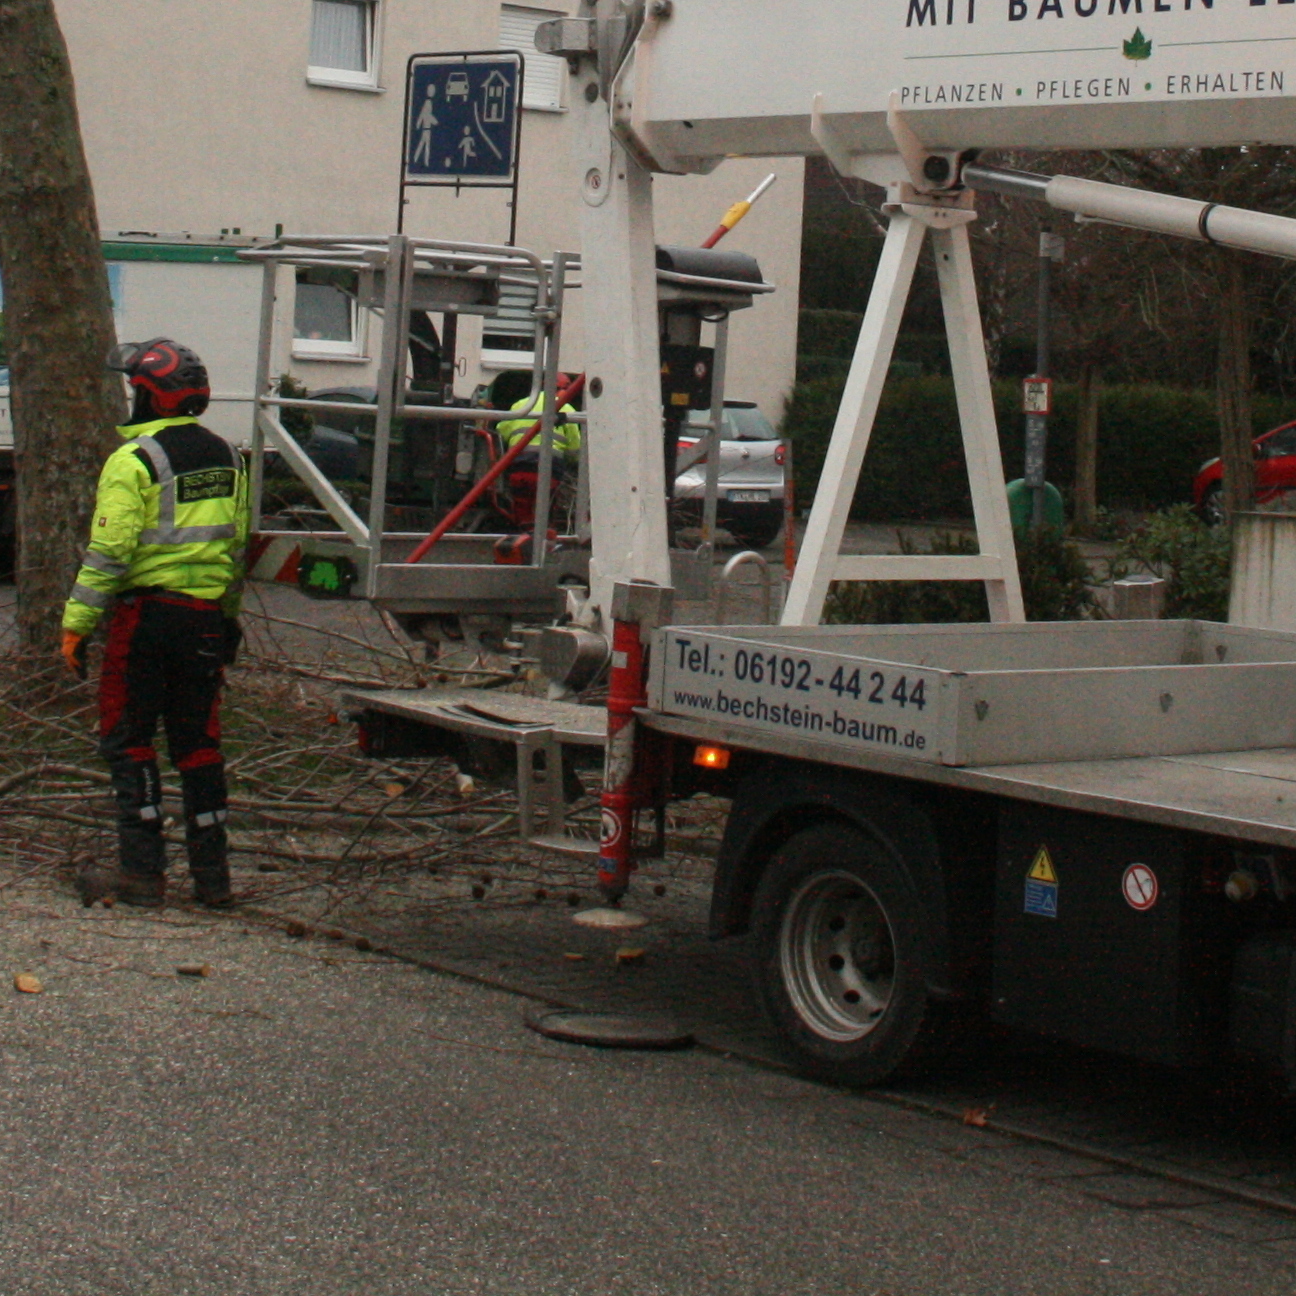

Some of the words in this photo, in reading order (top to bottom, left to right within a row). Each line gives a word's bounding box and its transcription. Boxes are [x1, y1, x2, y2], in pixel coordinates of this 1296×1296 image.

[901, 82, 1004, 105] PFLANZEN
[1036, 77, 1130, 100] PFLEGEN
[1166, 70, 1285, 94] ERHALTEN
[673, 690, 926, 749] www.bechstein-baum.de
